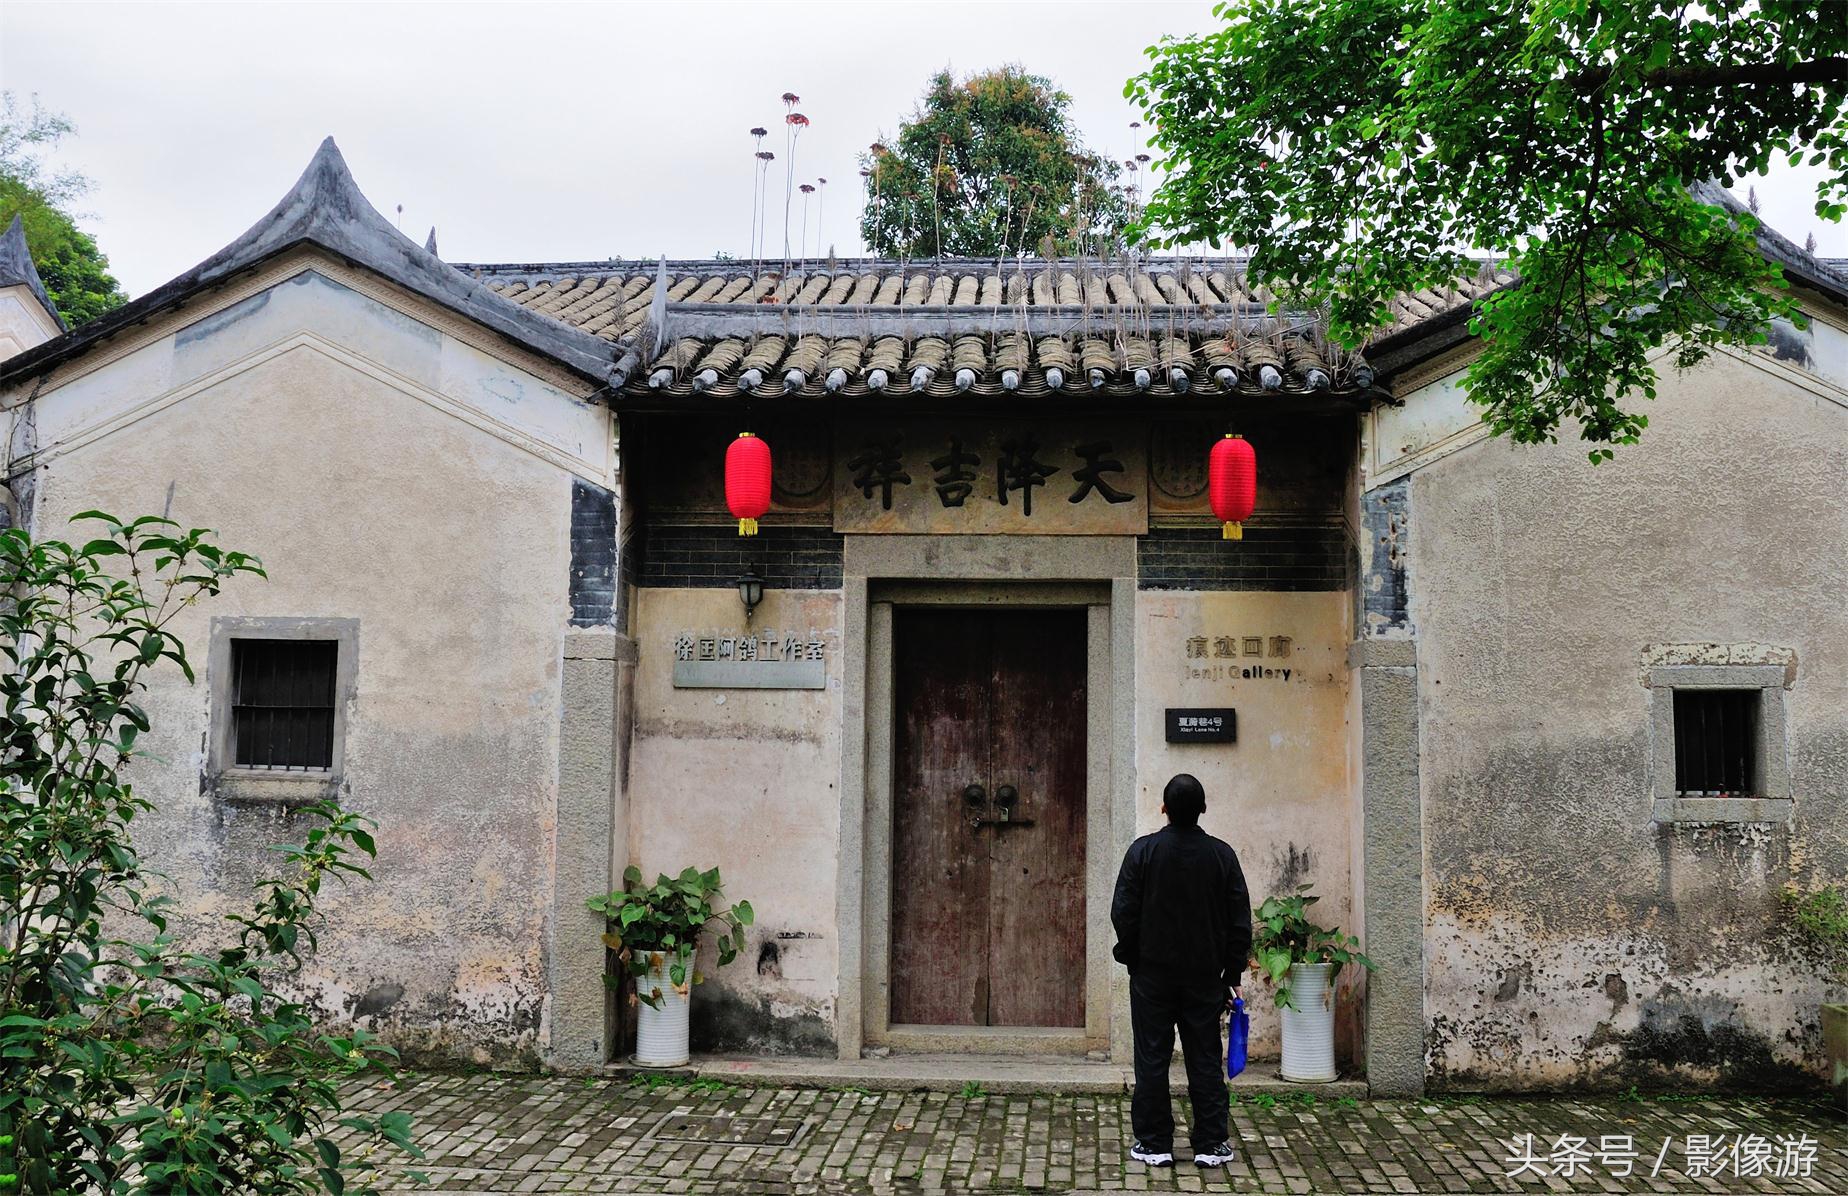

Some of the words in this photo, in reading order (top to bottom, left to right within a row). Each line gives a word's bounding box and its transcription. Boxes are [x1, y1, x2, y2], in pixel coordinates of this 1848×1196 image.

[847, 432, 1136, 517] 天降吉祥
[1228, 665, 1291, 681] Gallery
